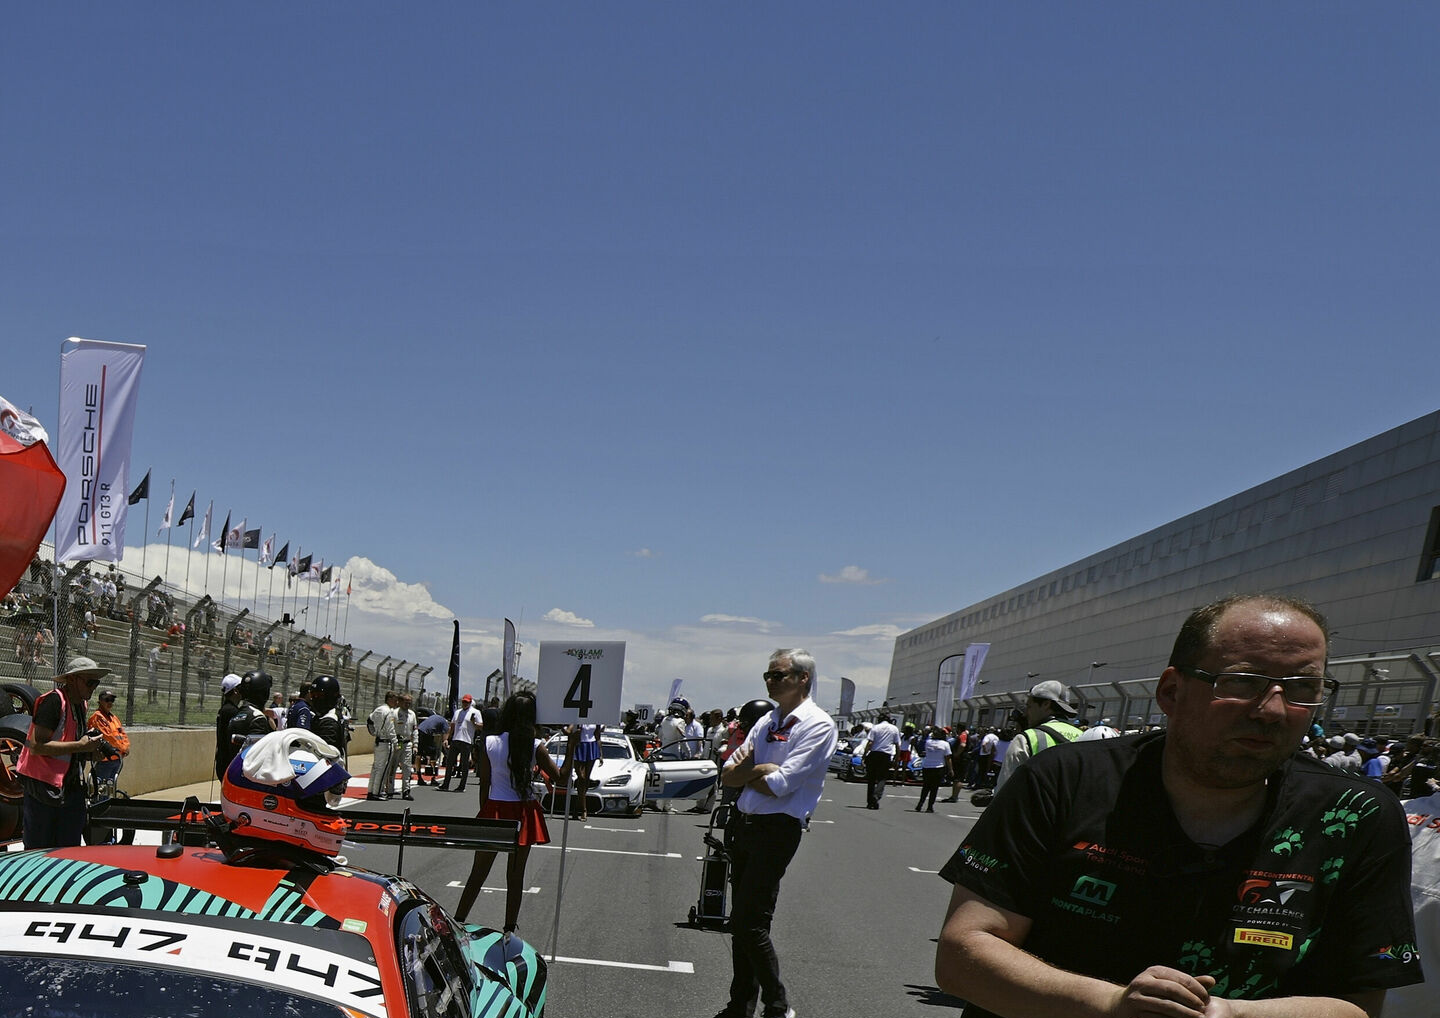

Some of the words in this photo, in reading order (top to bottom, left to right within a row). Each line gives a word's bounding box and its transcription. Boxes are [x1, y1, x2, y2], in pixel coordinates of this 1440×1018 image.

[77, 384, 98, 546] PORSCHE
[101, 483, 111, 491] R
[101, 496, 111, 519] GT3
[101, 523, 111, 546] 911
[563, 664, 593, 718] 4
[638, 708, 649, 720] 10
[24, 921, 188, 951] 947
[1240, 931, 1289, 947] PIRELLI
